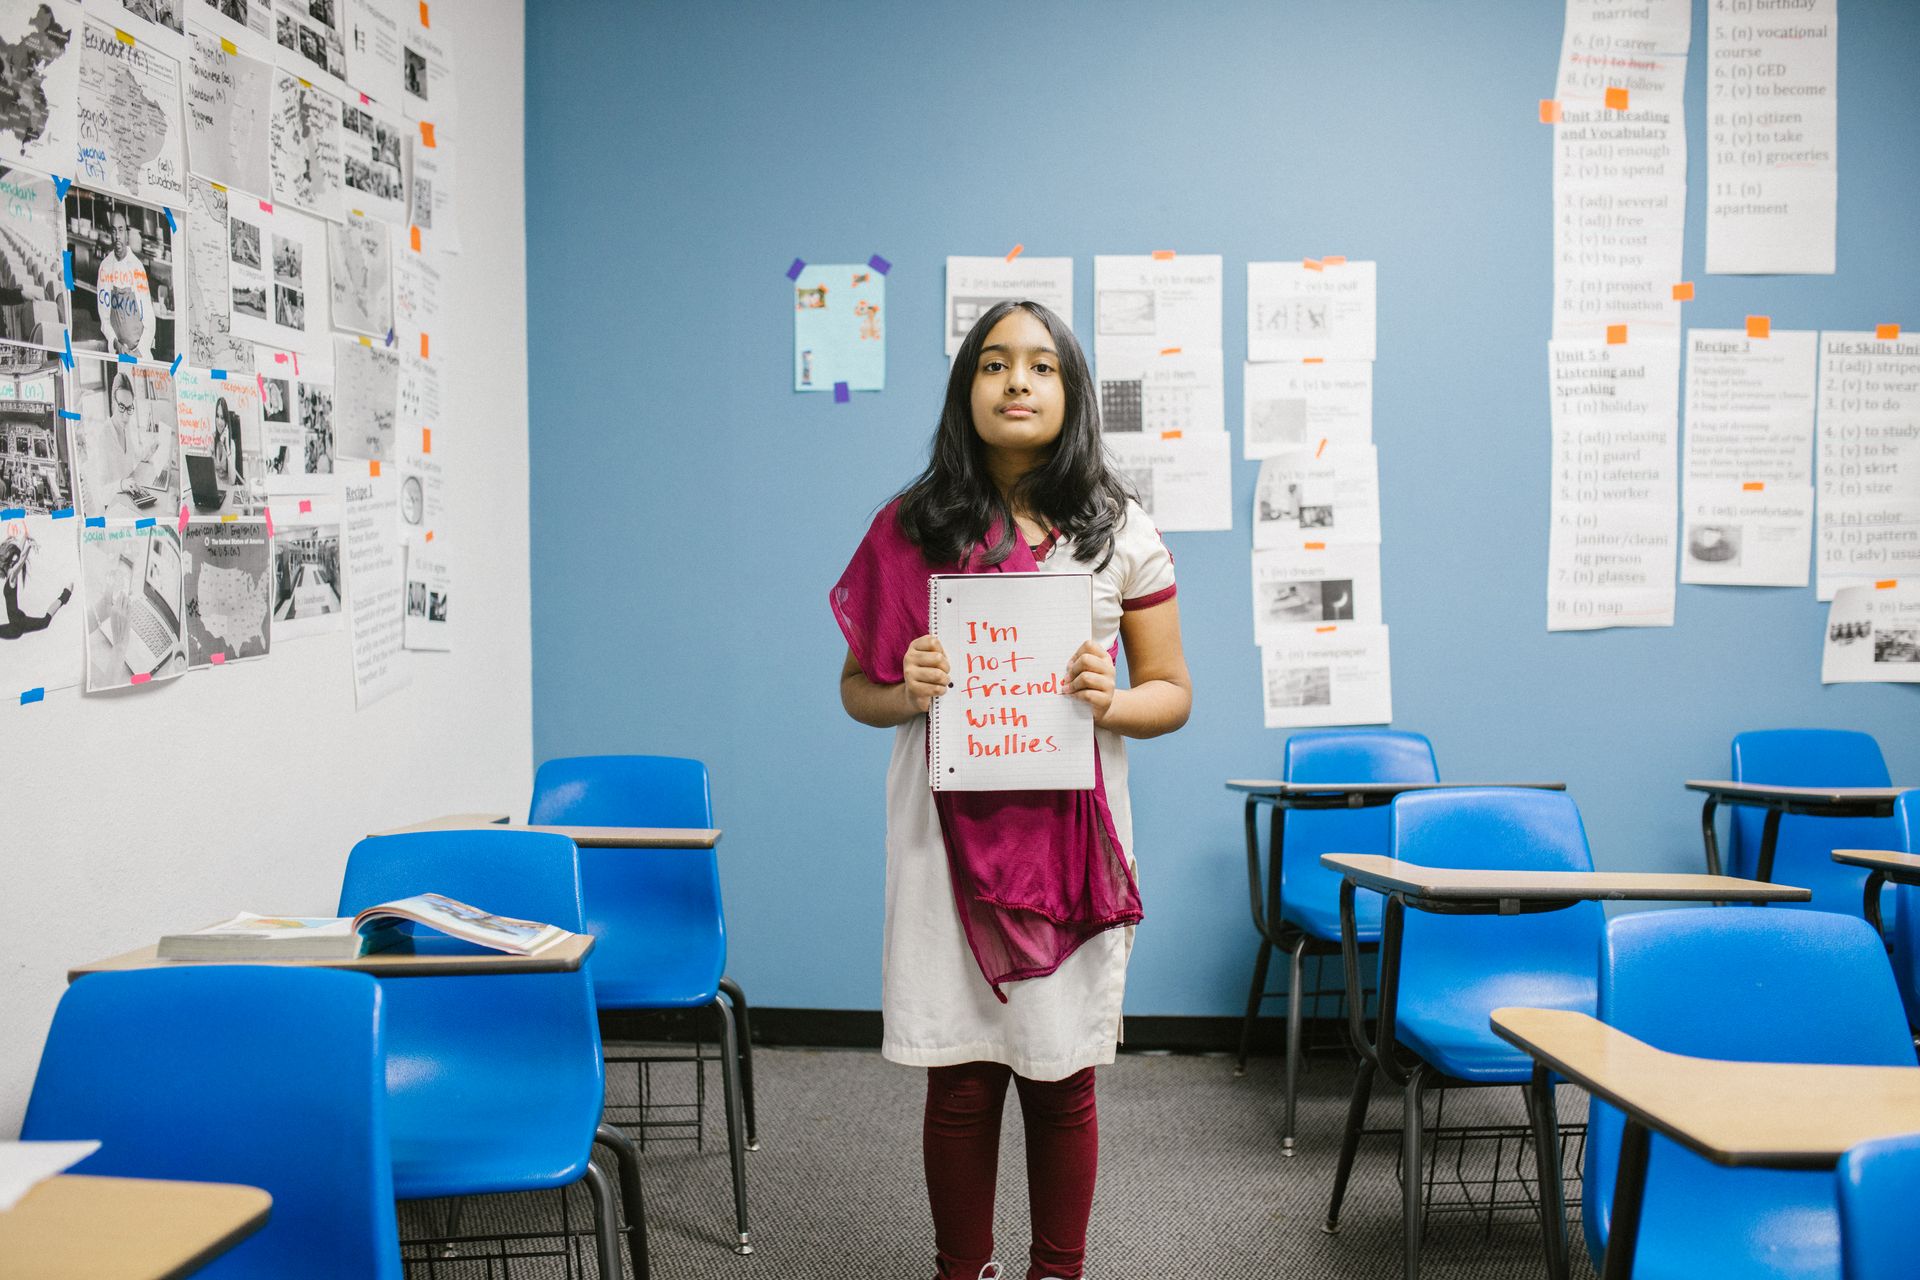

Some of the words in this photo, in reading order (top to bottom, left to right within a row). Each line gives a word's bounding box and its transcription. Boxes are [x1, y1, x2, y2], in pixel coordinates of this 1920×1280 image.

[1732, 25, 1752, 41] (n)
[1757, 24, 1828, 40] vocational
[1715, 46, 1762, 59] course
[1732, 64, 1752, 81] (n)
[1757, 64, 1786, 77] GED
[1732, 83, 1752, 100] (v)
[1756, 85, 1770, 96] to
[1773, 83, 1826, 96] become
[1562, 110, 1590, 122] Unit
[1617, 110, 1670, 124] Reading
[1732, 112, 1752, 128] (n)
[1757, 112, 1802, 125] citizen
[1561, 127, 1587, 140] and
[1591, 126, 1667, 141] Vocabulary
[1733, 132, 1752, 149] (v)
[1757, 131, 1770, 143] to
[1774, 130, 1803, 143] take
[1617, 145, 1670, 159] enough
[1741, 150, 1762, 168] (n)
[1766, 147, 1829, 165] groceries
[1604, 165, 1618, 176] to
[1623, 164, 1665, 179] spend
[1741, 183, 1762, 200] (n)
[1617, 195, 1668, 208] several
[1715, 203, 1788, 217] apartment
[1616, 215, 1644, 226] free
[1620, 255, 1643, 268] pay
[1606, 279, 1653, 295] project
[1606, 298, 1664, 312] situation
[1695, 341, 1740, 354] Recipe
[1828, 342, 1853, 354] Life
[1857, 342, 1892, 355] Skills
[1556, 350, 1584, 362] Unit
[1557, 366, 1617, 379] Listening
[1620, 366, 1645, 378] and
[1557, 383, 1616, 397] Speaking
[1842, 379, 1862, 393] (v)
[1865, 380, 1879, 391] to
[1883, 381, 1919, 392] wear
[1601, 400, 1649, 415] holiday
[1841, 397, 1861, 413] (v)
[1865, 399, 1878, 410] to
[1882, 398, 1900, 410] do
[1615, 431, 1667, 445] relaxing
[1841, 425, 1861, 440] (v)
[1865, 427, 1879, 437] to
[1883, 424, 1920, 439] study
[1603, 449, 1641, 464] guard
[1841, 444, 1860, 458] (v)
[1865, 445, 1878, 455] to
[1882, 443, 1899, 455] be
[1603, 469, 1660, 481] cafeteria
[1840, 463, 1861, 478] (n)
[1865, 463, 1898, 474] skirt
[1603, 487, 1649, 499] worker
[1840, 481, 1861, 497] (n)
[1865, 482, 1893, 494] size
[1841, 511, 1862, 526] (n)
[1866, 510, 1902, 523] color
[1841, 530, 1862, 546] (n)
[1866, 530, 1917, 544] pattern
[1595, 555, 1642, 567] person
[1850, 548, 1887, 563] (adv)
[1597, 570, 1647, 584] glasses
[1598, 601, 1623, 616] nap
[966, 621, 1018, 644] I'm
[966, 651, 1035, 674] not
[966, 707, 1028, 728] with
[967, 733, 1061, 757] bullies.
